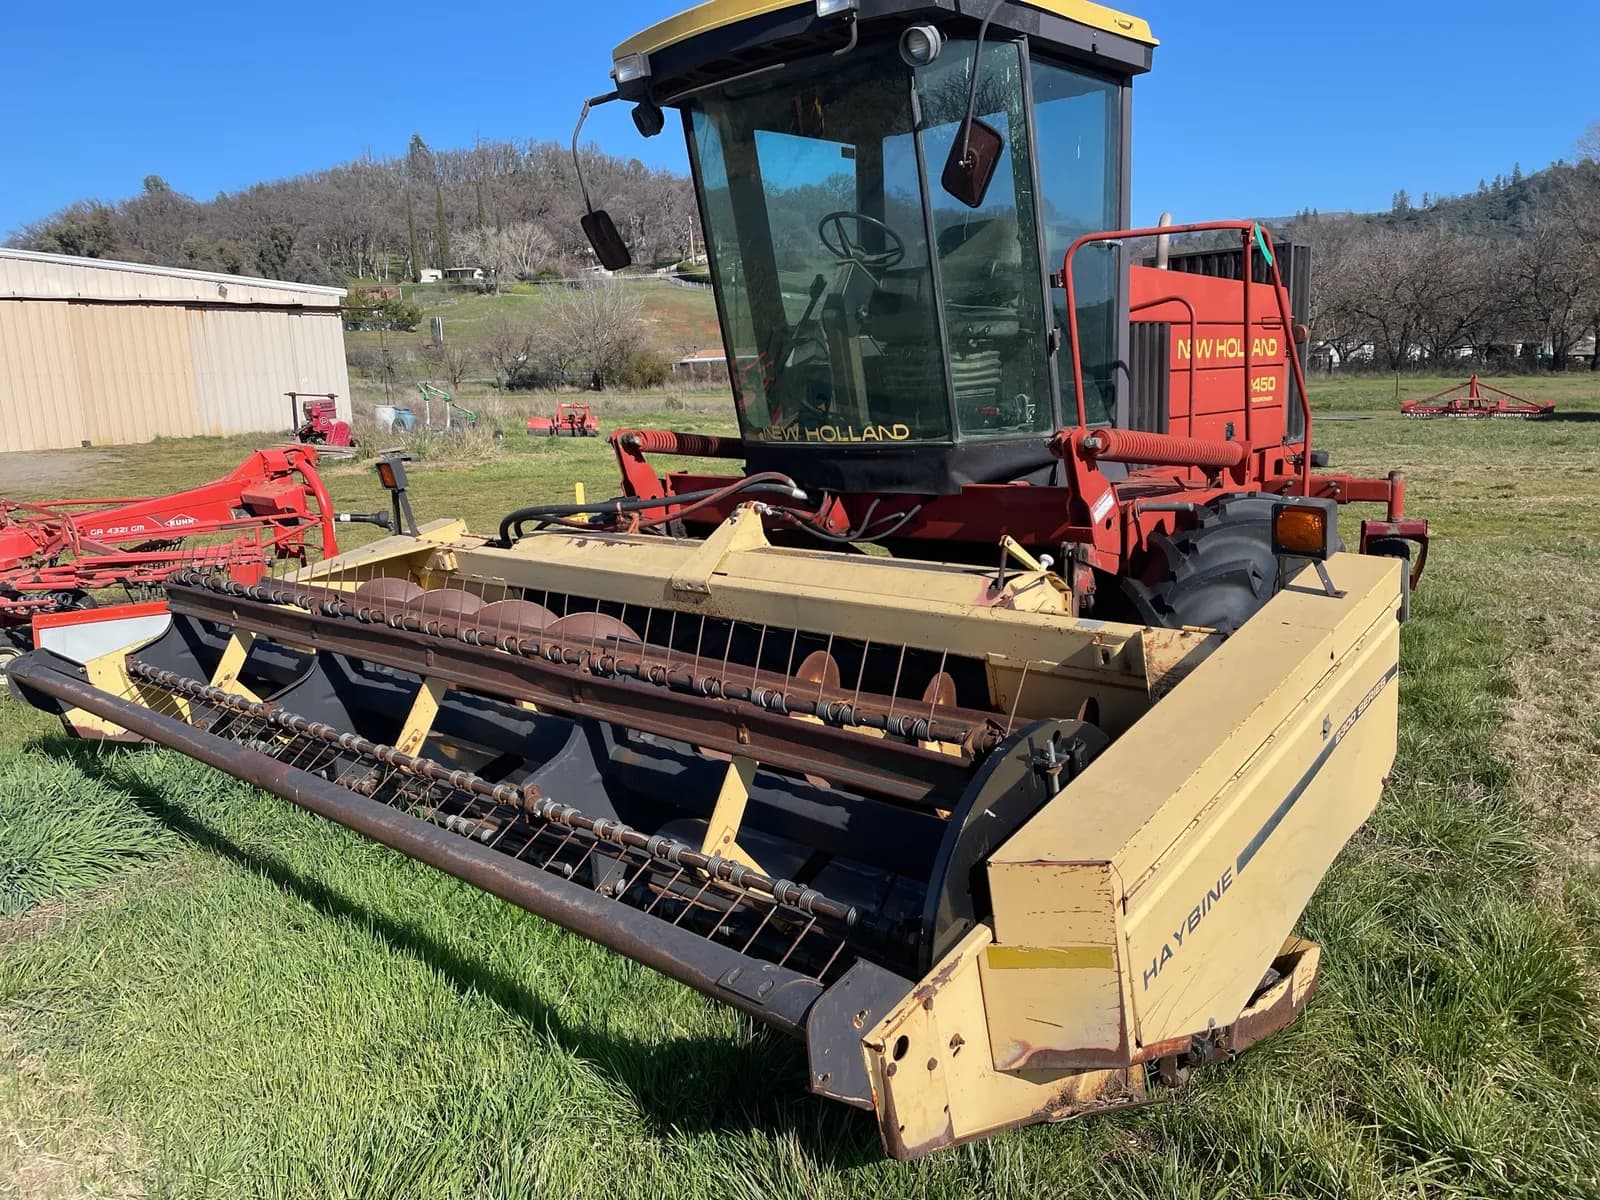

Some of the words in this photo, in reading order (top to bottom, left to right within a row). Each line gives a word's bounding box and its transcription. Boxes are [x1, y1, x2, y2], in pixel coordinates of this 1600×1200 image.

[1177, 338, 1213, 359] NW
[1216, 337, 1278, 358] HOLAND
[1250, 376, 1276, 392] 450
[762, 424, 800, 441] NEW
[805, 423, 910, 442] HOLLAND
[106, 526, 128, 534] 4321
[130, 524, 145, 533] GM
[169, 518, 194, 527] KUHN
[1357, 675, 1387, 716] SERIES
[1143, 866, 1233, 991] HAYBINE
